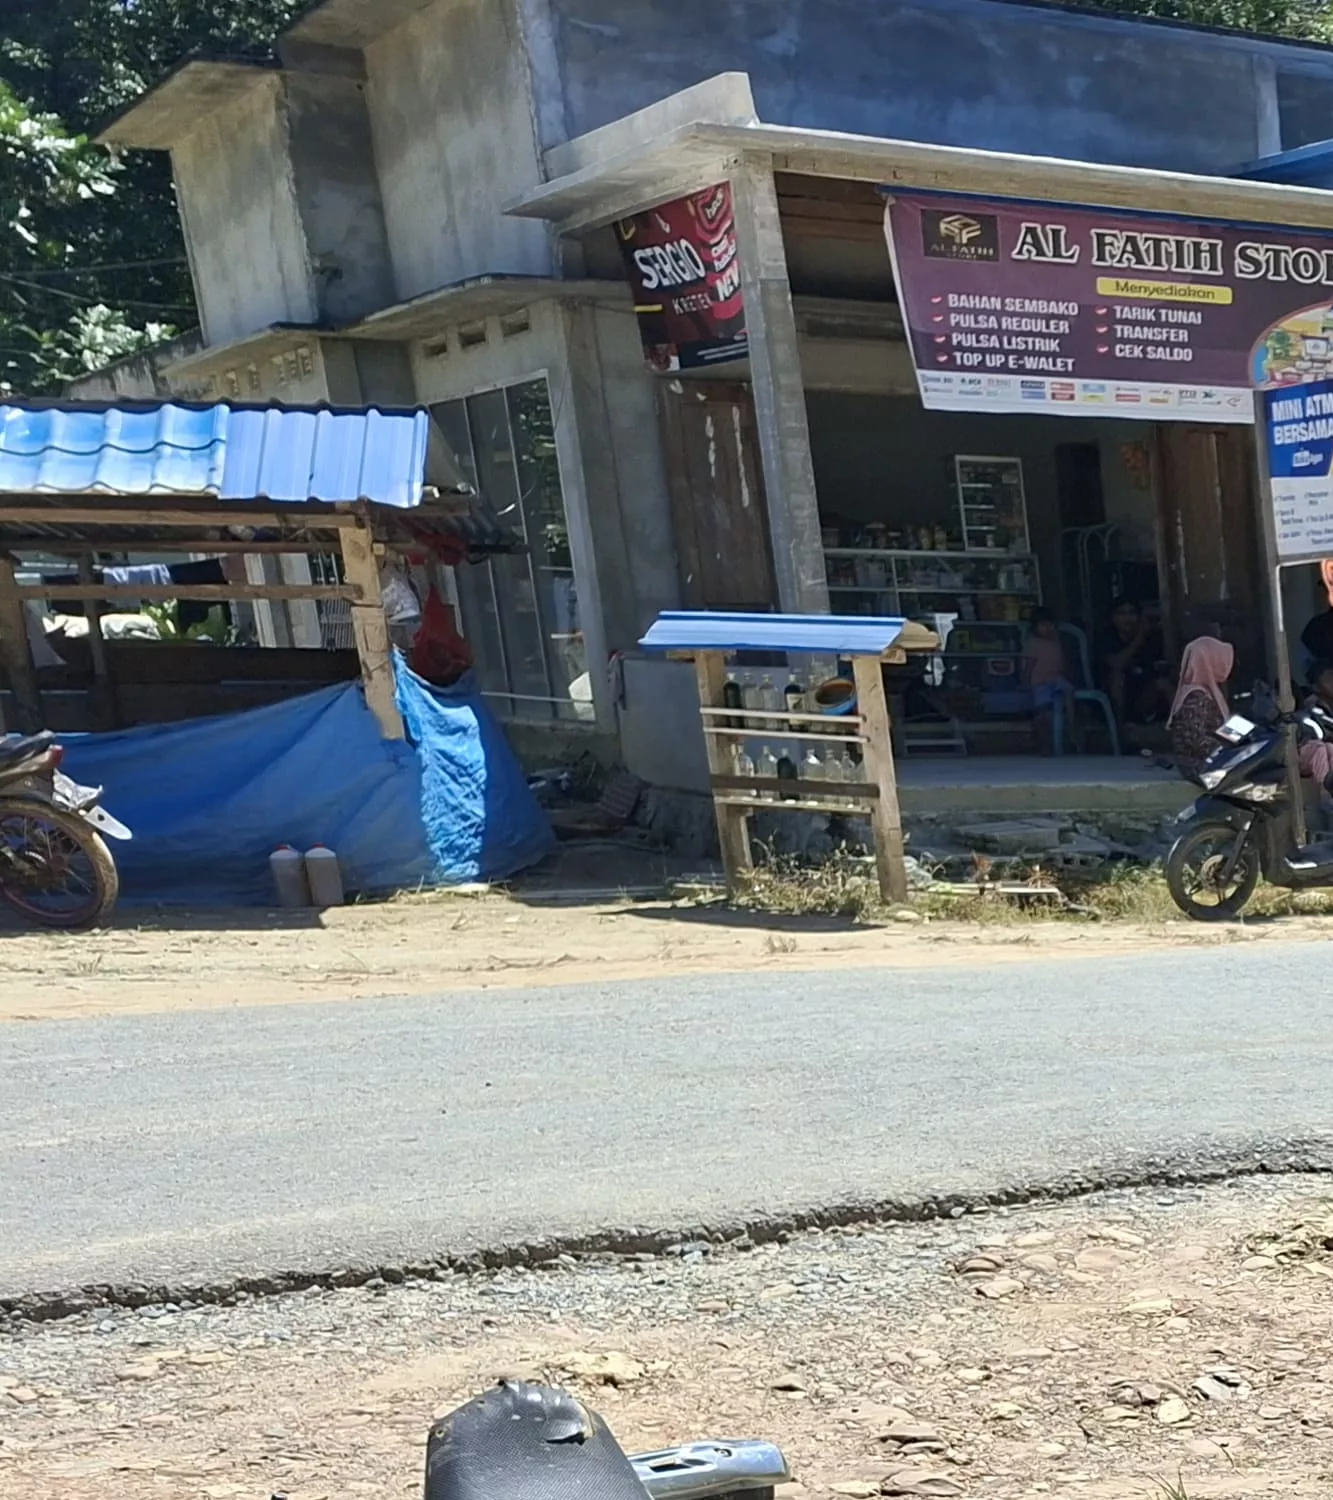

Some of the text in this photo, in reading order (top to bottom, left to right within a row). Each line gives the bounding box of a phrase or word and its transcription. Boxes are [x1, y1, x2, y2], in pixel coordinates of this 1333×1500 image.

[1011, 222, 1080, 264] AL
[1090, 228, 1223, 275] FATIH
[634, 238, 705, 290] SERGIO
[1115, 280, 1215, 300] Menyediakan
[947, 293, 1079, 316] BAHAN SEMBAKO
[1113, 305, 1202, 325] TARIK TUNAI
[950, 313, 998, 329] PULSA
[951, 332, 1061, 353] PULSA LISTRIK
[1113, 324, 1189, 342] TRANSFER
[952, 351, 1076, 372] TOP UP E-WALET
[1114, 343, 1193, 361] CEK SALDO
[1272, 399, 1303, 422] MINI
